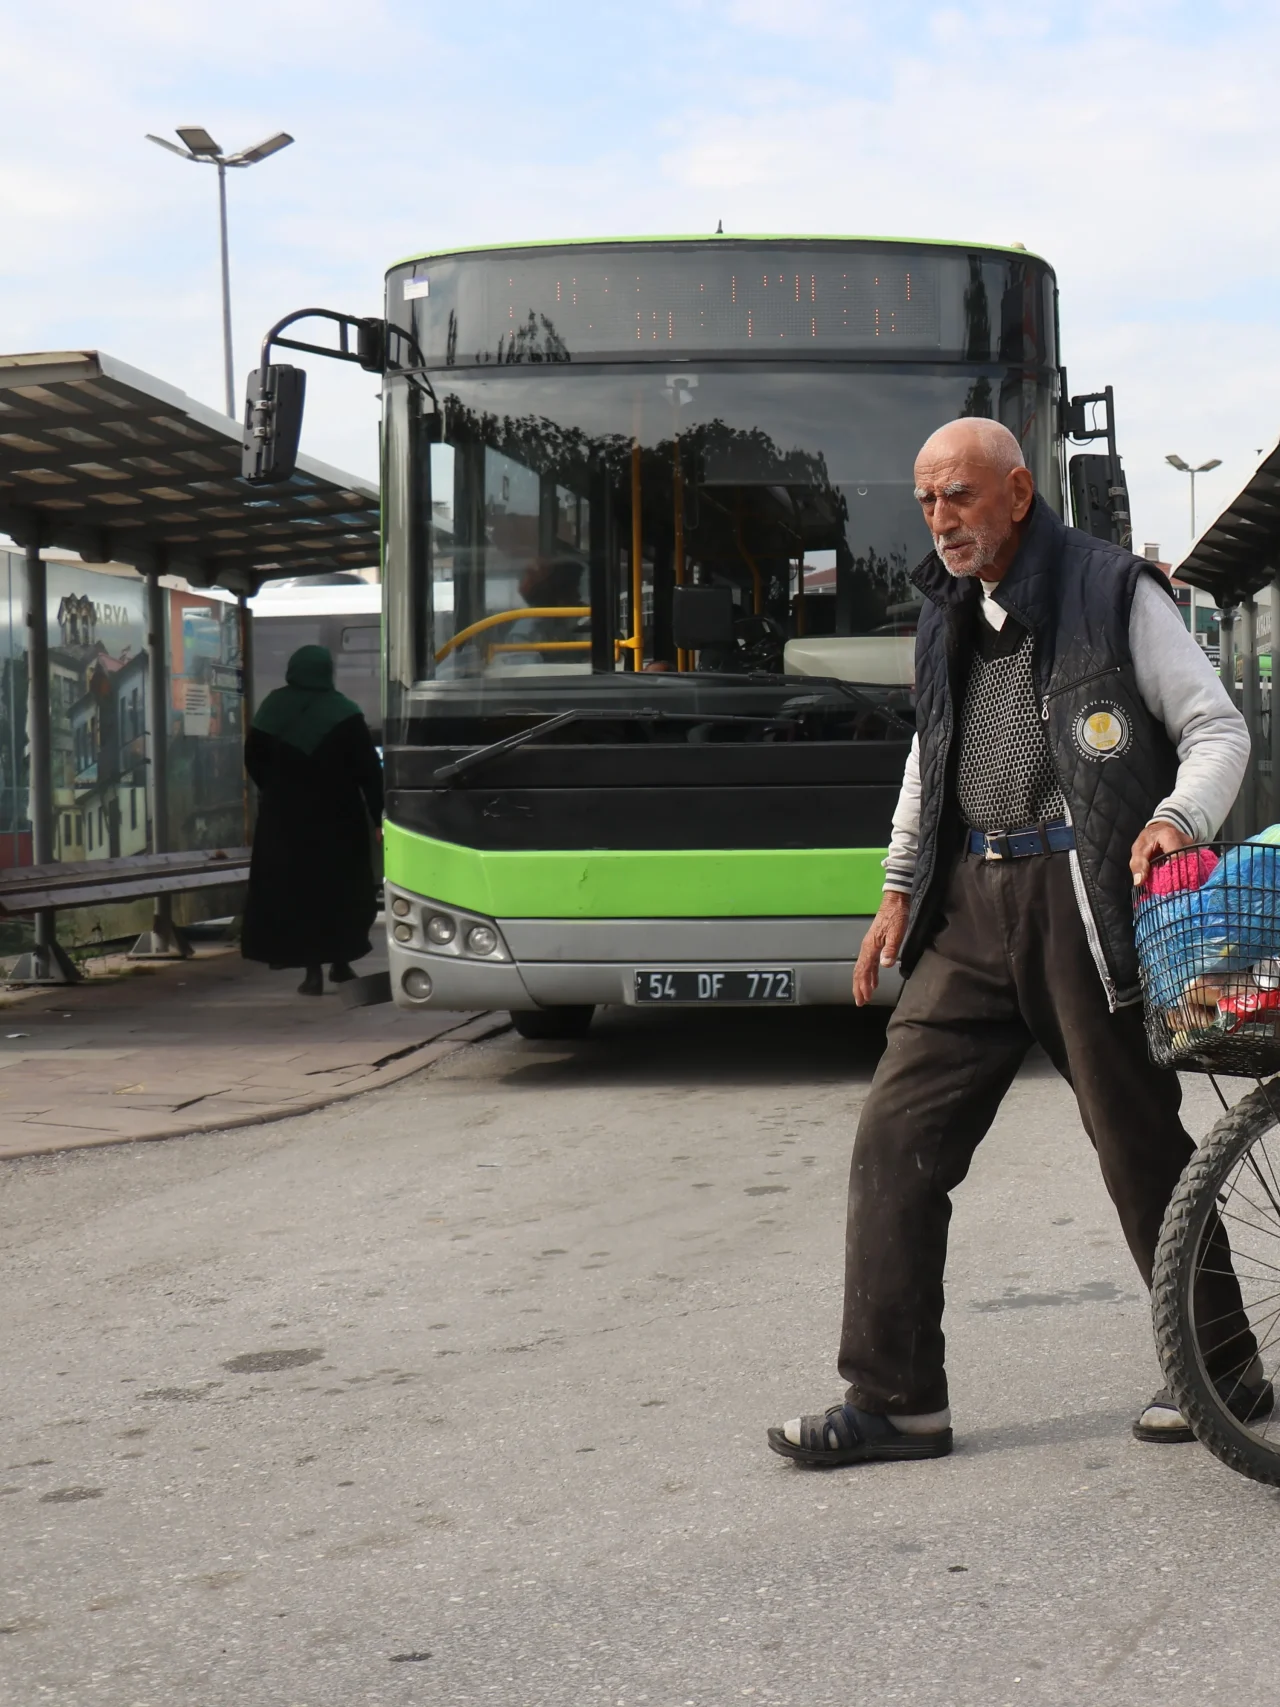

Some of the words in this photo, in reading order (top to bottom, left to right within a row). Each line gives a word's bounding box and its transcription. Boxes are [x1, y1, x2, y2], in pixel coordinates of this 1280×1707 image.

[649, 973, 677, 999] 54
[697, 972, 726, 998] DF
[746, 973, 790, 998] 772
